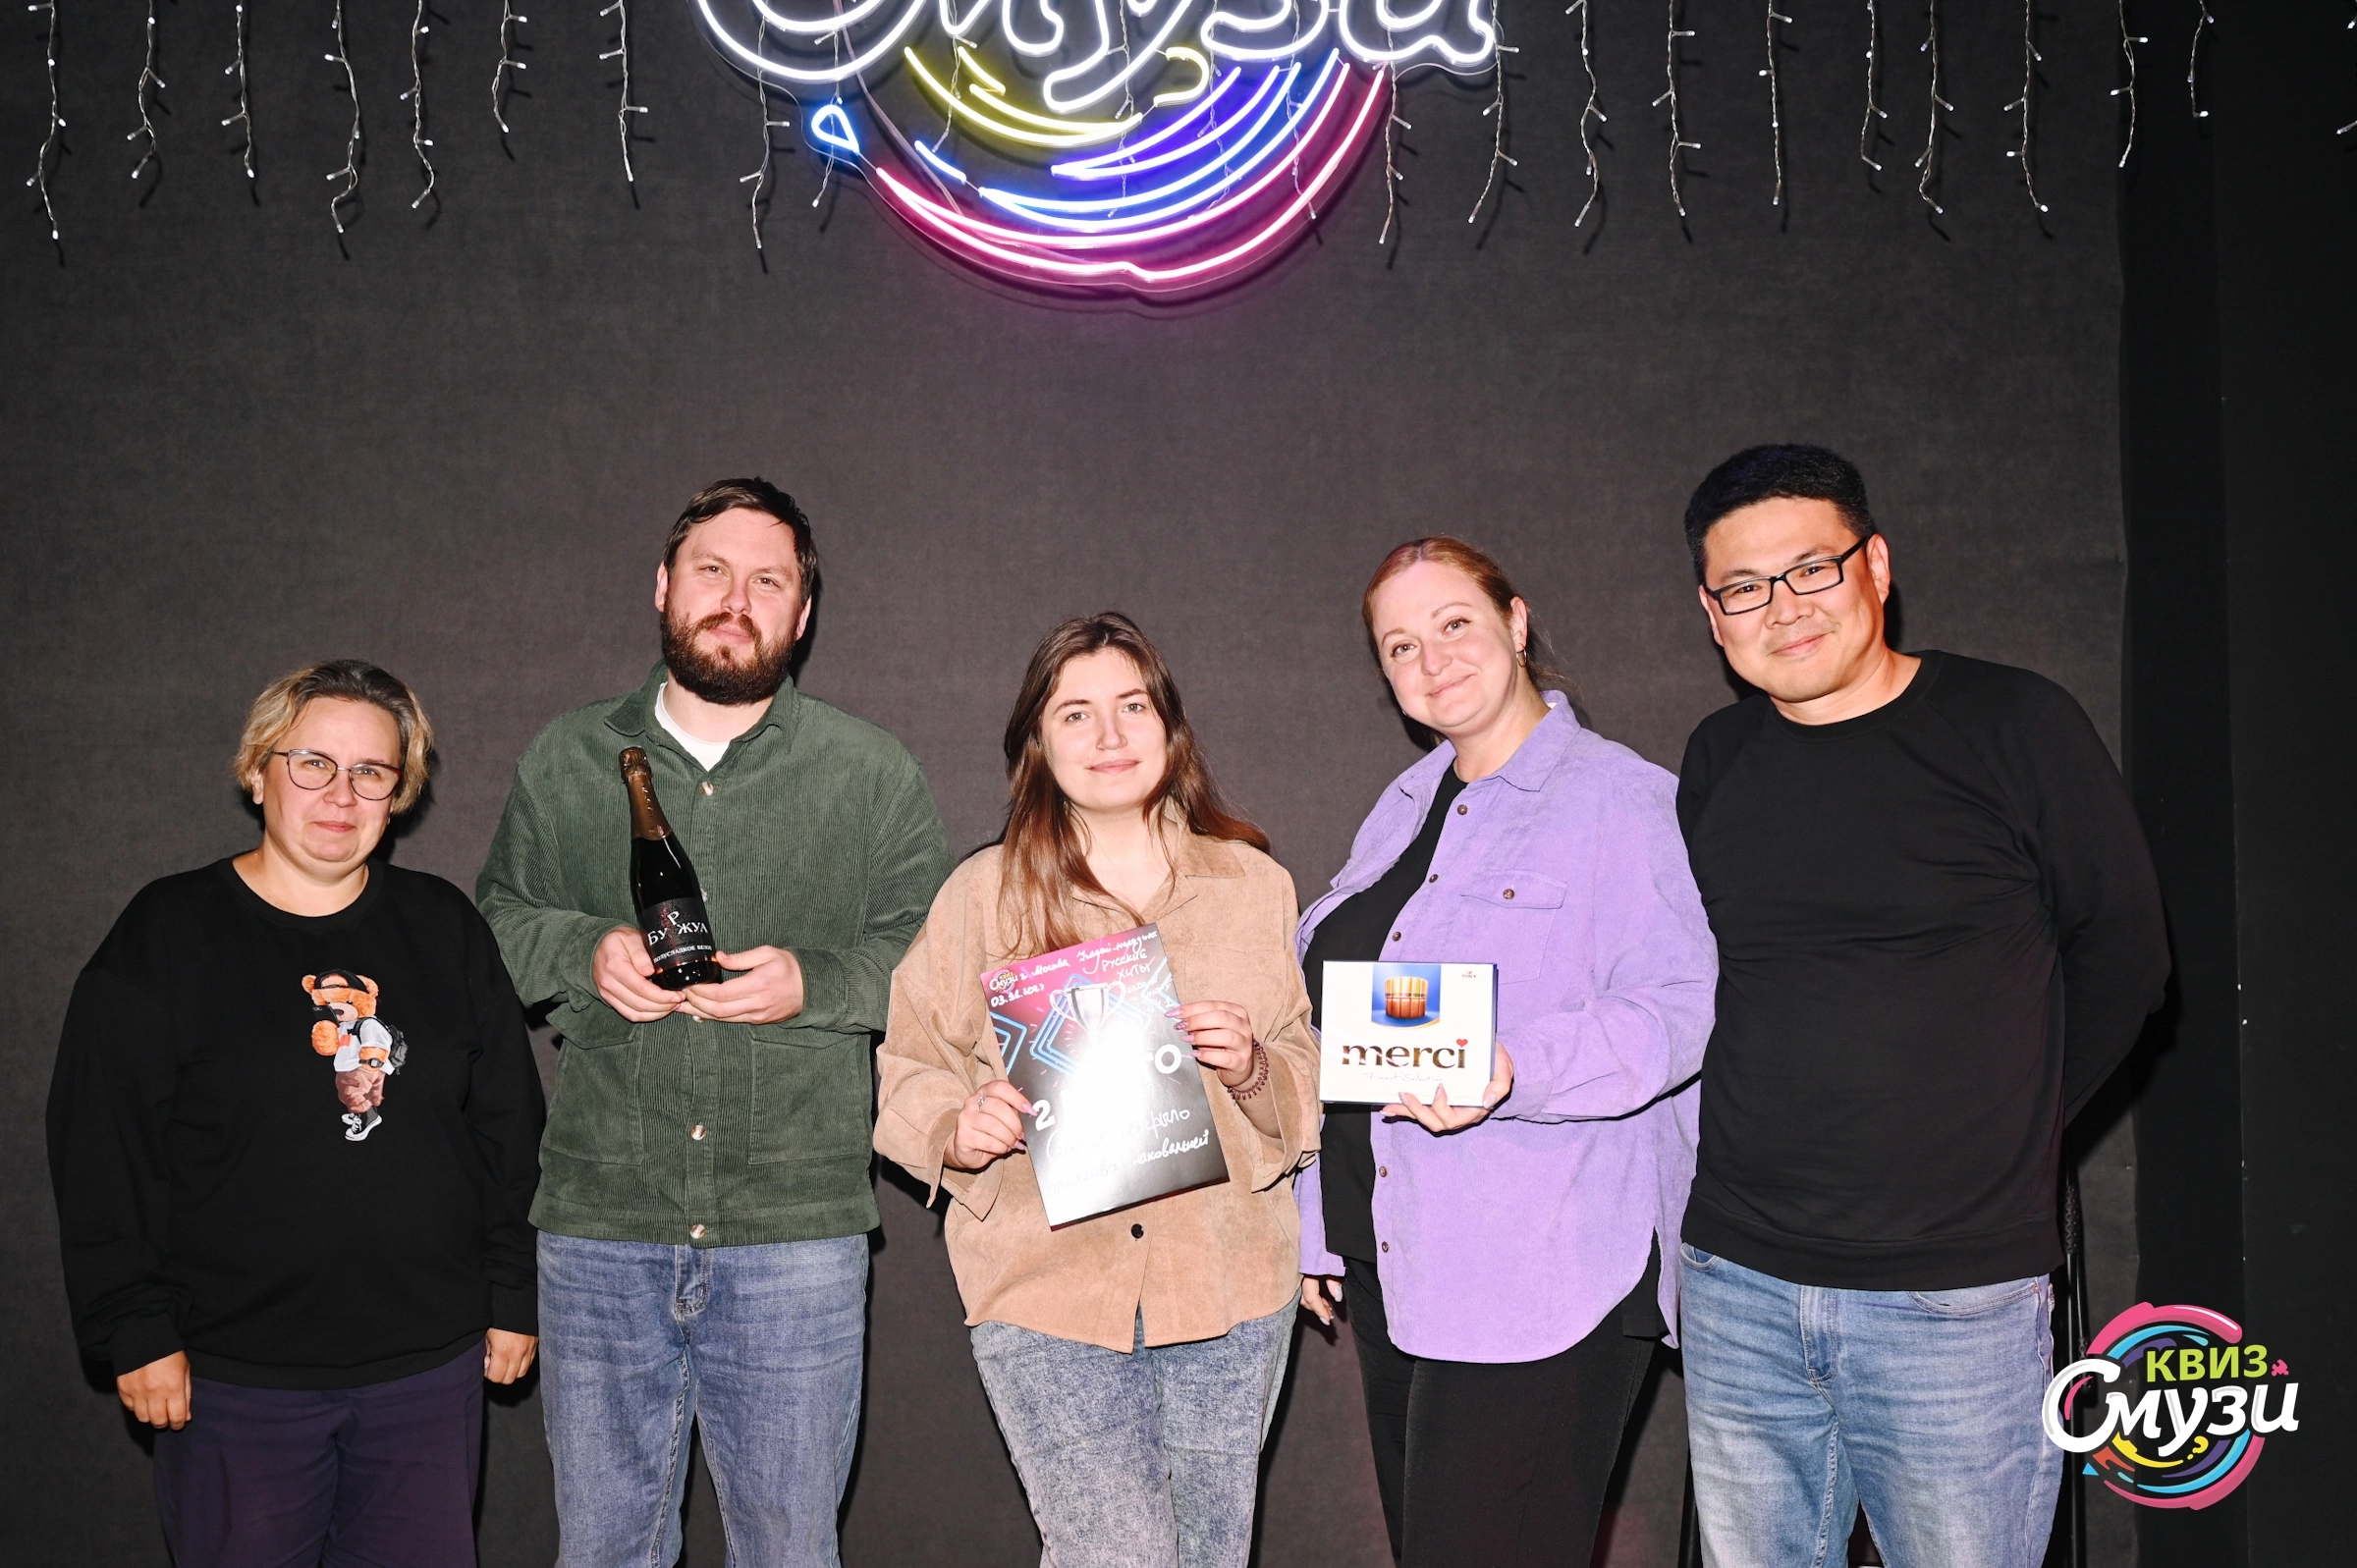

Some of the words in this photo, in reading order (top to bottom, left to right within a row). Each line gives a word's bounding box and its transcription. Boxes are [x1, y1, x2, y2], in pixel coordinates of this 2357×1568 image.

[988, 972, 1018, 992] Смузи
[1342, 1039, 1468, 1069] merci
[1364, 1071, 1399, 1082] Finest
[1401, 1073, 1446, 1083] Selection
[1034, 1099, 1055, 1131] 2
